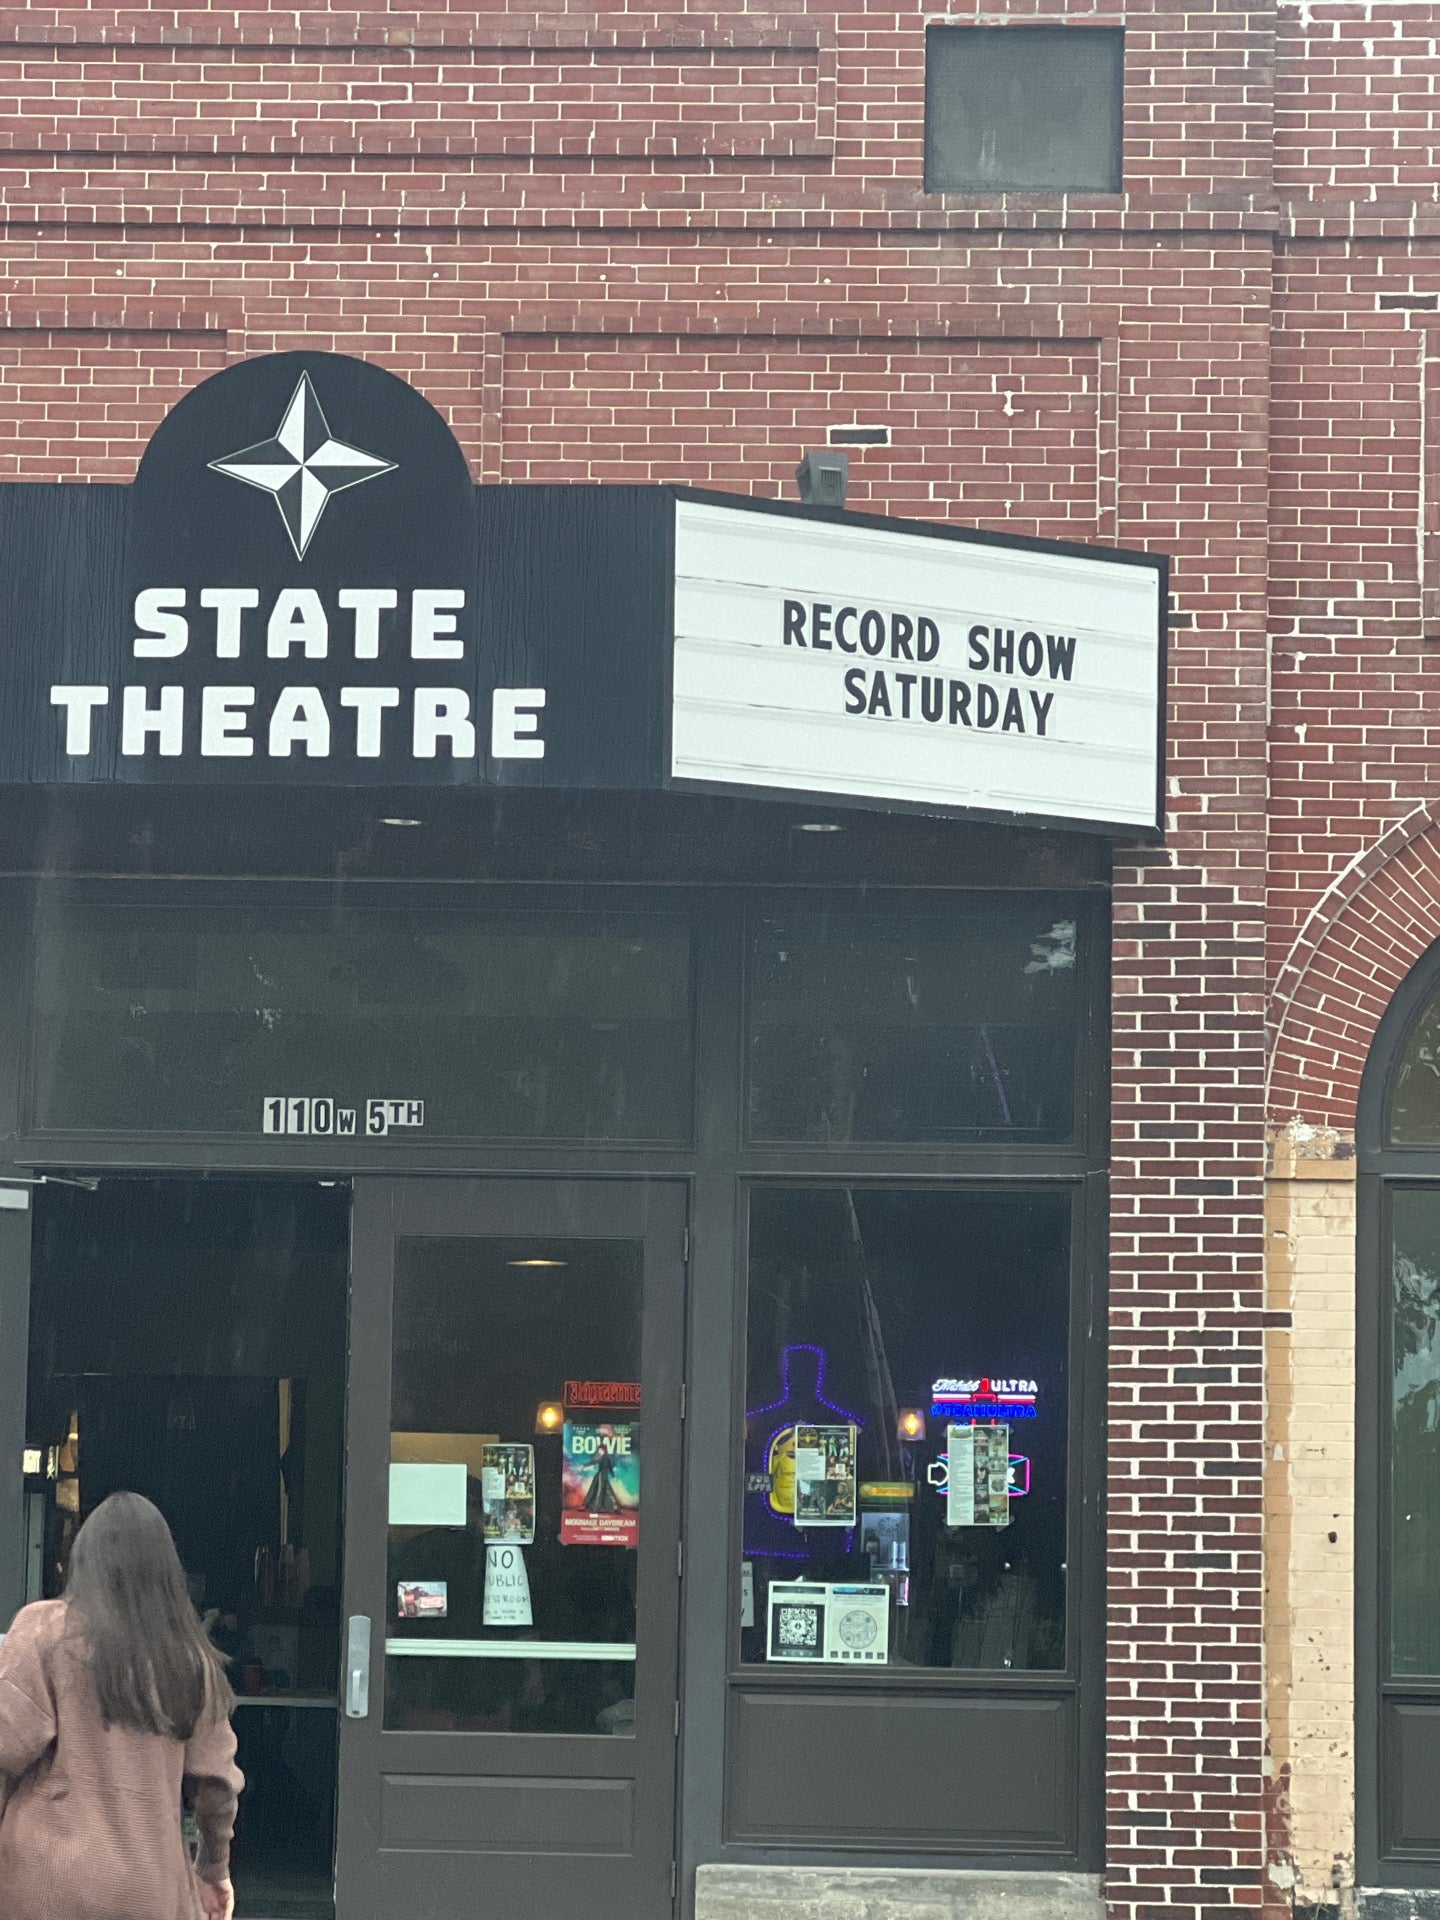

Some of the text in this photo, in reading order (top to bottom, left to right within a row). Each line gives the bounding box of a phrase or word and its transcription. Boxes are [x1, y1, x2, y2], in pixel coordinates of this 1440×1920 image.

[133, 587, 466, 660] STATE
[782, 598, 1077, 682] RECORD SHOW
[844, 667, 1056, 737] SATURDAY
[50, 684, 547, 760] THEATRE
[368, 1100, 423, 1134] 5TH
[990, 1378, 1039, 1393] ULTRA
[571, 1435, 632, 1455] BOWIE
[488, 1550, 514, 1569] NO
[486, 1573, 525, 1587] UBLIC
